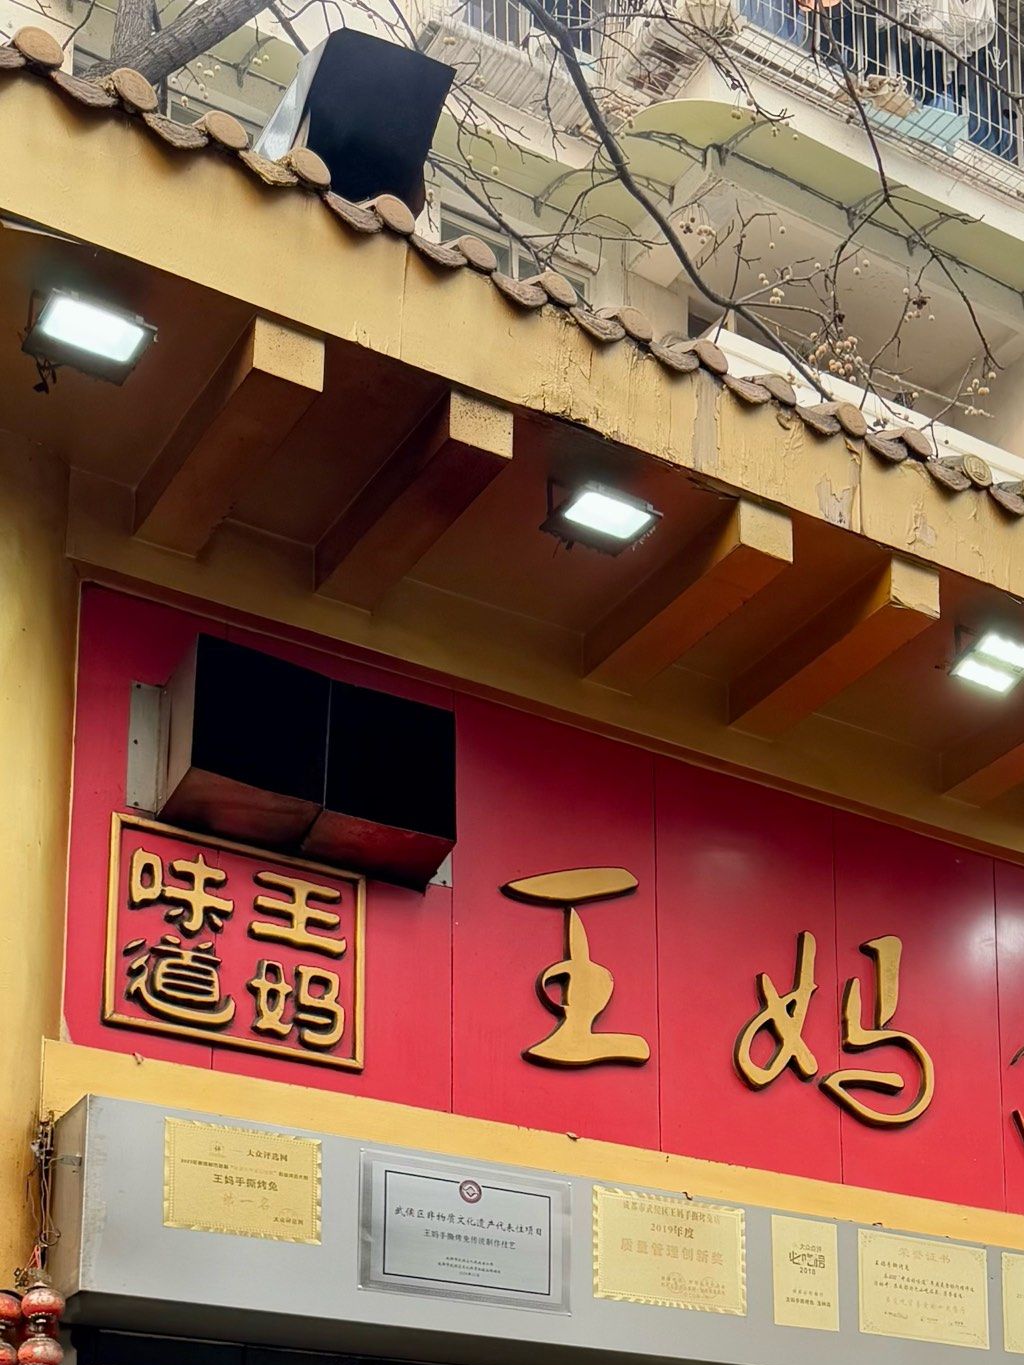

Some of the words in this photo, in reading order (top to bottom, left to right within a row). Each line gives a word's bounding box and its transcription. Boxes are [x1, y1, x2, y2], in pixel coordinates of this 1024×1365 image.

[650, 1223, 695, 1239] 2019年度
[620, 1237, 724, 1266] 质量管理创新奖
